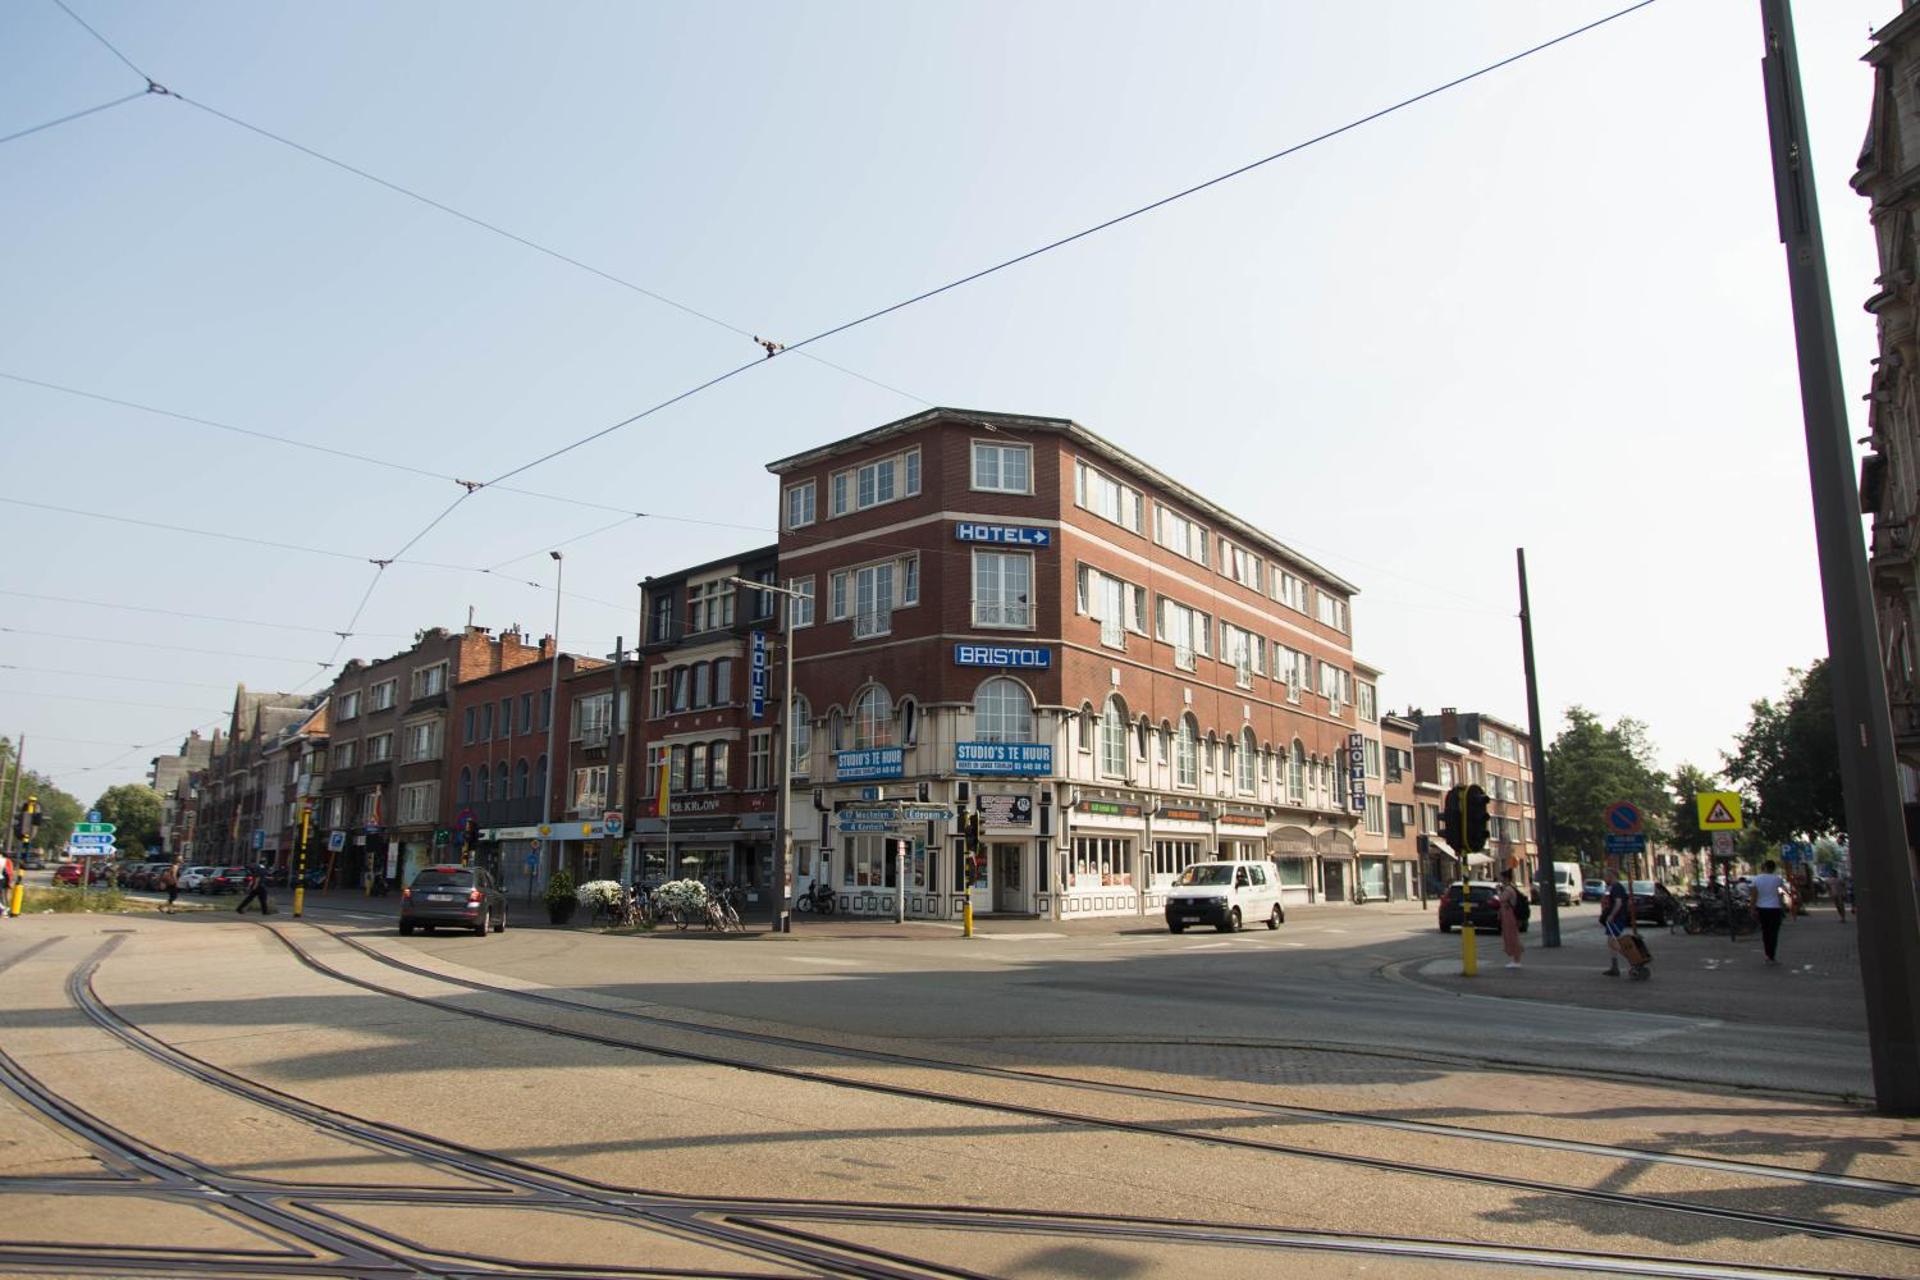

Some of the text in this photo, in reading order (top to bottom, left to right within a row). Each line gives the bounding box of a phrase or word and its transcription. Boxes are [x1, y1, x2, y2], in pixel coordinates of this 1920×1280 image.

[960, 524, 1033, 543] HOTEL
[960, 646, 1047, 666] BRISTOL
[753, 634, 765, 717] HOTEL
[839, 749, 902, 767] STUDIO'S TE HUUR
[958, 745, 1050, 760] STUDIO'S TE HUUR
[1351, 735, 1364, 810] HOTEL
[909, 810, 941, 820] Edegem
